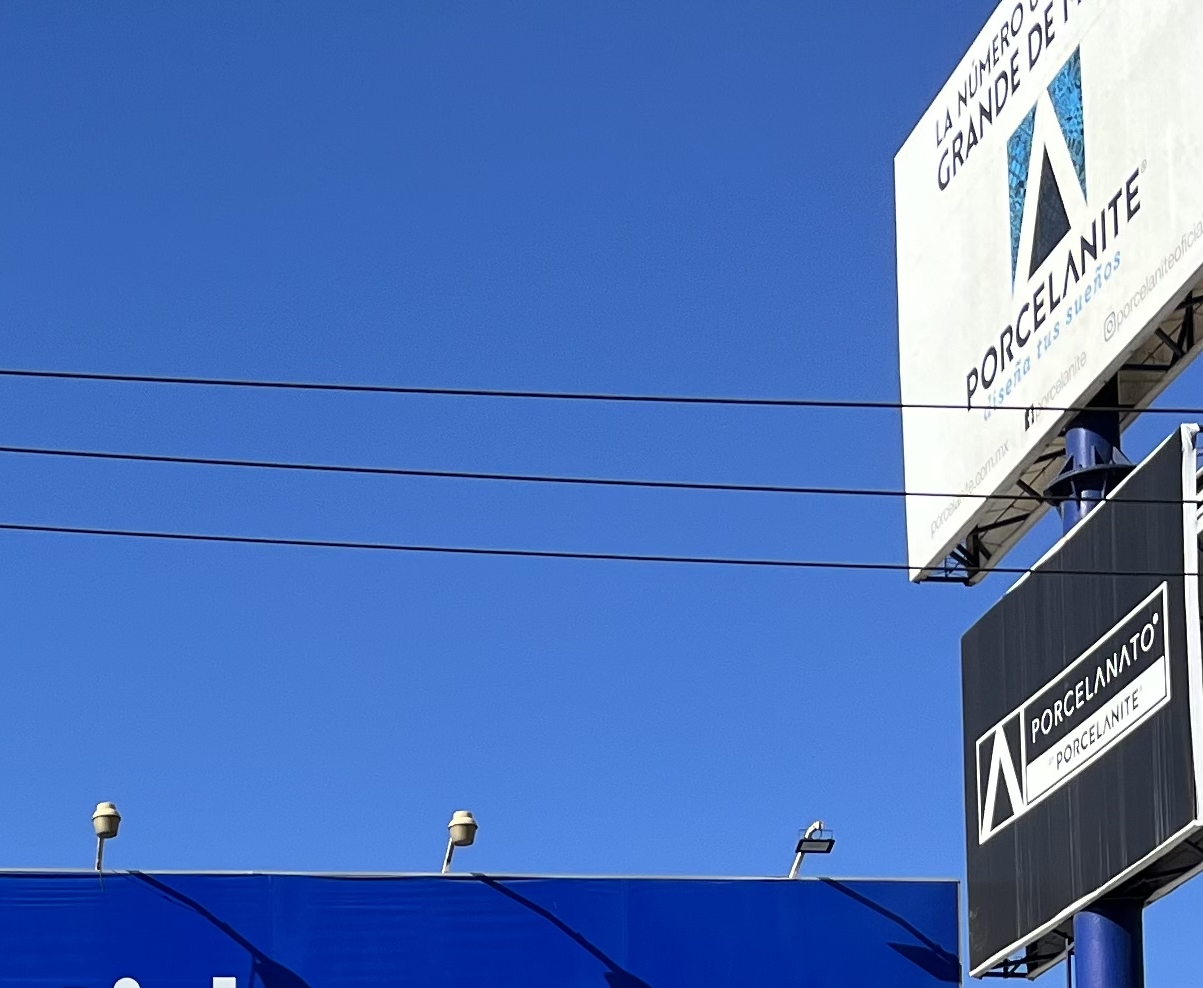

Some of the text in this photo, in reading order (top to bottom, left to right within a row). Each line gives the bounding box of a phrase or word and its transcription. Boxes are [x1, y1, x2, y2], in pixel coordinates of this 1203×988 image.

[936, 2, 1024, 148] LA NÚMERO
[938, 0, 1056, 191] GRANDE DE
[966, 166, 1141, 412] PORCELANITE
[983, 250, 1121, 422] diseña tus sueños
[1116, 211, 1203, 332] porcelaniteoficia
[1031, 623, 1155, 743] PORCELANATO
[1056, 688, 1139, 770] PORCELANITE
